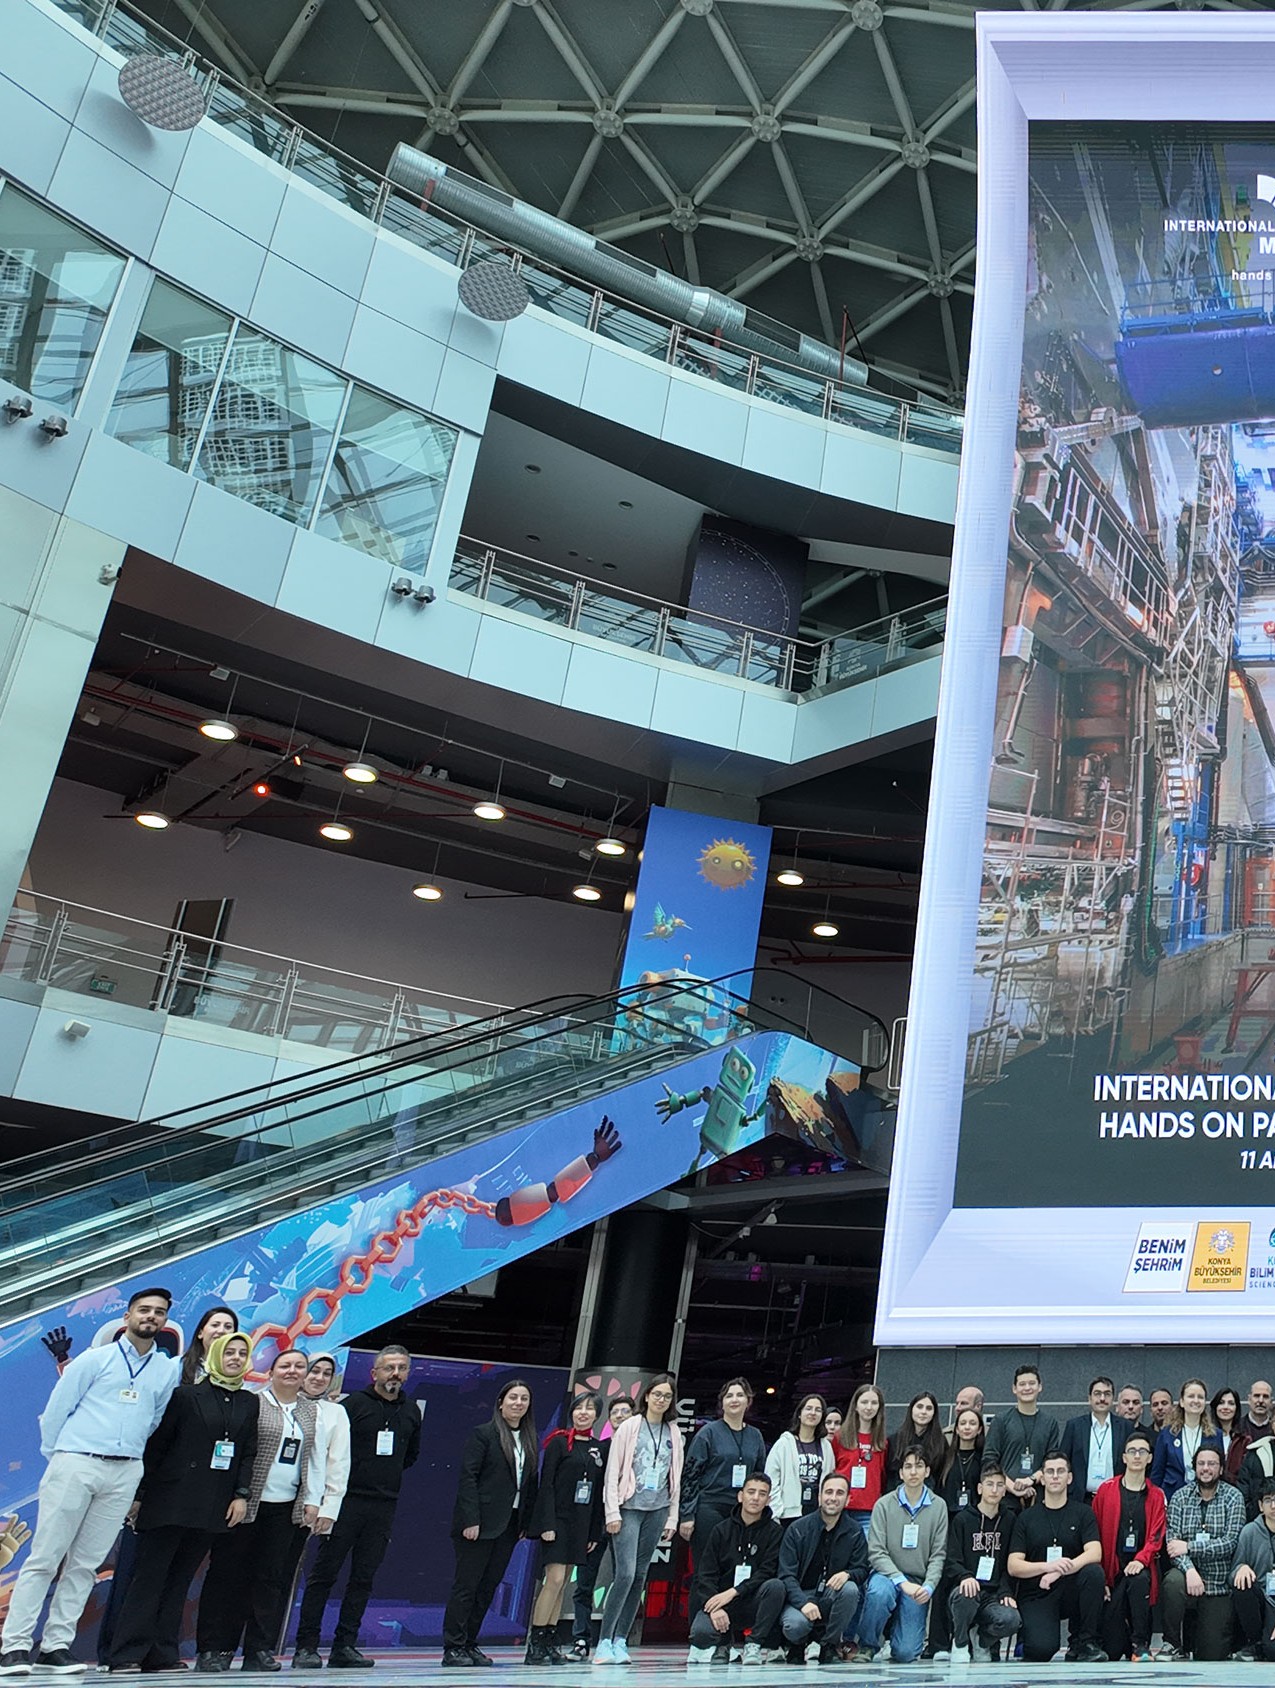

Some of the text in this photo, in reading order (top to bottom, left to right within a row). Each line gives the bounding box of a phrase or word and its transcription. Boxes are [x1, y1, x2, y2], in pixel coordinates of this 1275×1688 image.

[1164, 219, 1275, 233] INTERNATIONAL
[1231, 269, 1272, 281] hands
[1099, 1111, 1195, 1139] HANDS
[1202, 1111, 1244, 1138] ON
[1240, 1150, 1256, 1169] 11
[1207, 1257, 1232, 1265] KONYA
